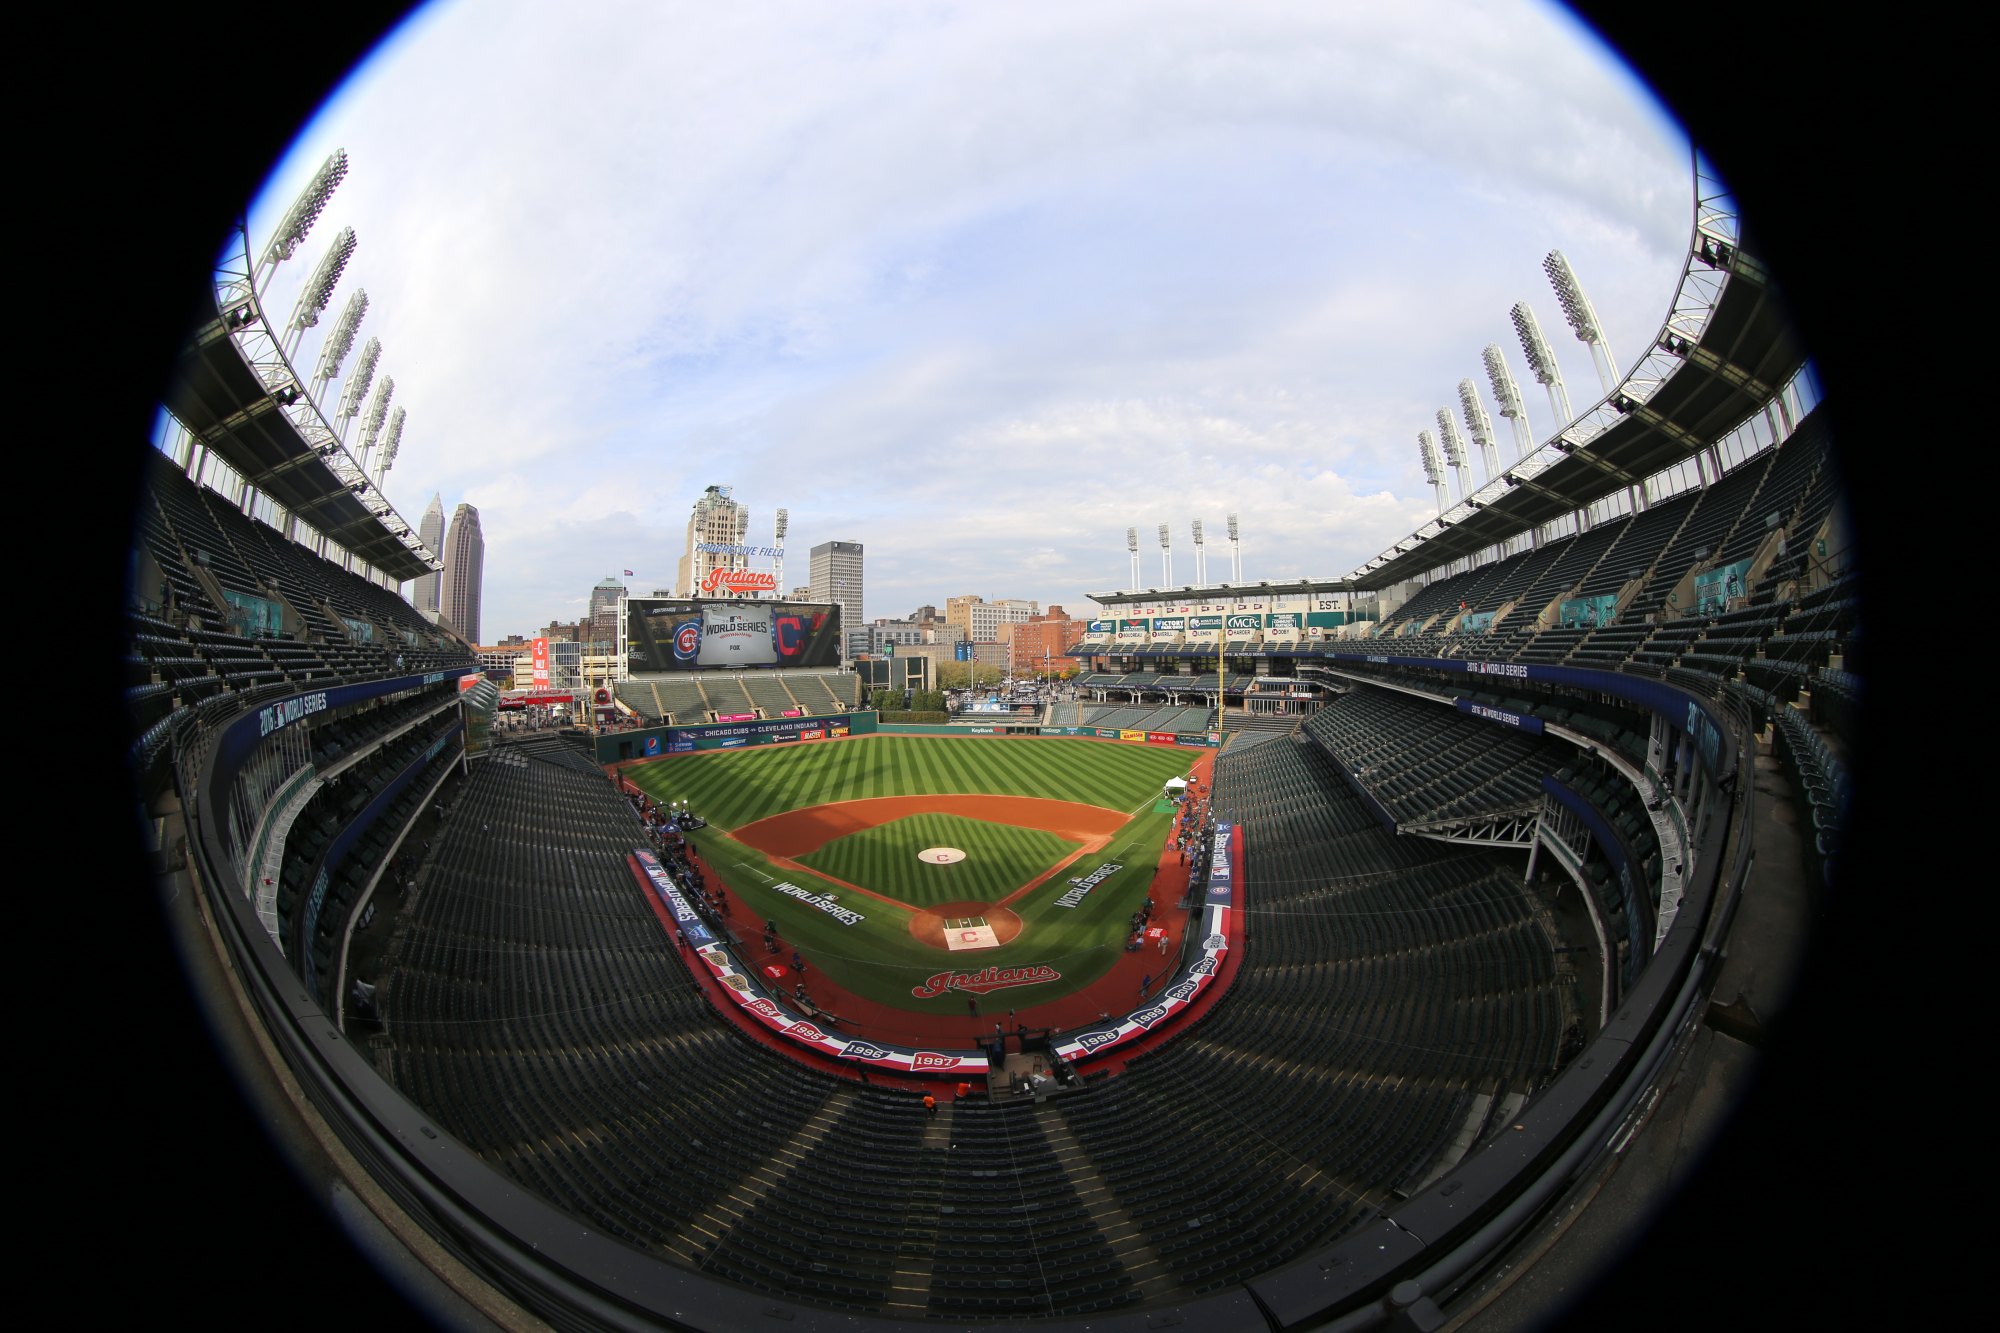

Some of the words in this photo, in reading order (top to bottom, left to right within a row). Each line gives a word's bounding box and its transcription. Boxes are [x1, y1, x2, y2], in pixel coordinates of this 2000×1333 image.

[696, 543, 758, 556] PROGRESSIVE
[759, 547, 784, 557] FIELD
[701, 567, 776, 595] Indians
[1319, 601, 1341, 610] EST.
[706, 623, 736, 636] WORLD
[737, 622, 767, 633] SERIES
[1467, 662, 1477, 672] 2016
[1487, 663, 1505, 675] WORLD
[1506, 665, 1528, 678] SERIES
[260, 707, 274, 737] 2016
[284, 698, 303, 723] WORLD
[304, 693, 327, 715] SERIES
[1472, 705, 1480, 715] 2016
[1488, 709, 1502, 721] WORLD
[1503, 713, 1520, 726] SERIES
[705, 728, 732, 737] CHICAGO
[757, 723, 793, 733] CLEVELAND
[1053, 882, 1094, 908] WORLD
[1084, 863, 1123, 884] SERIES
[652, 875, 681, 898] WORLD
[672, 897, 699, 921] SERIES
[772, 882, 822, 904] WORLD
[815, 900, 865, 926] SERIES
[961, 932, 978, 943] C
[1196, 957, 1215, 973] 2007
[911, 966, 1061, 998] Indians
[1172, 982, 1197, 998] 2001
[751, 1001, 777, 1016] 1954
[792, 1024, 821, 1040] 1995
[1081, 1032, 1116, 1047] 1998
[847, 1044, 883, 1059] 1996
[916, 1056, 954, 1067] 1997
